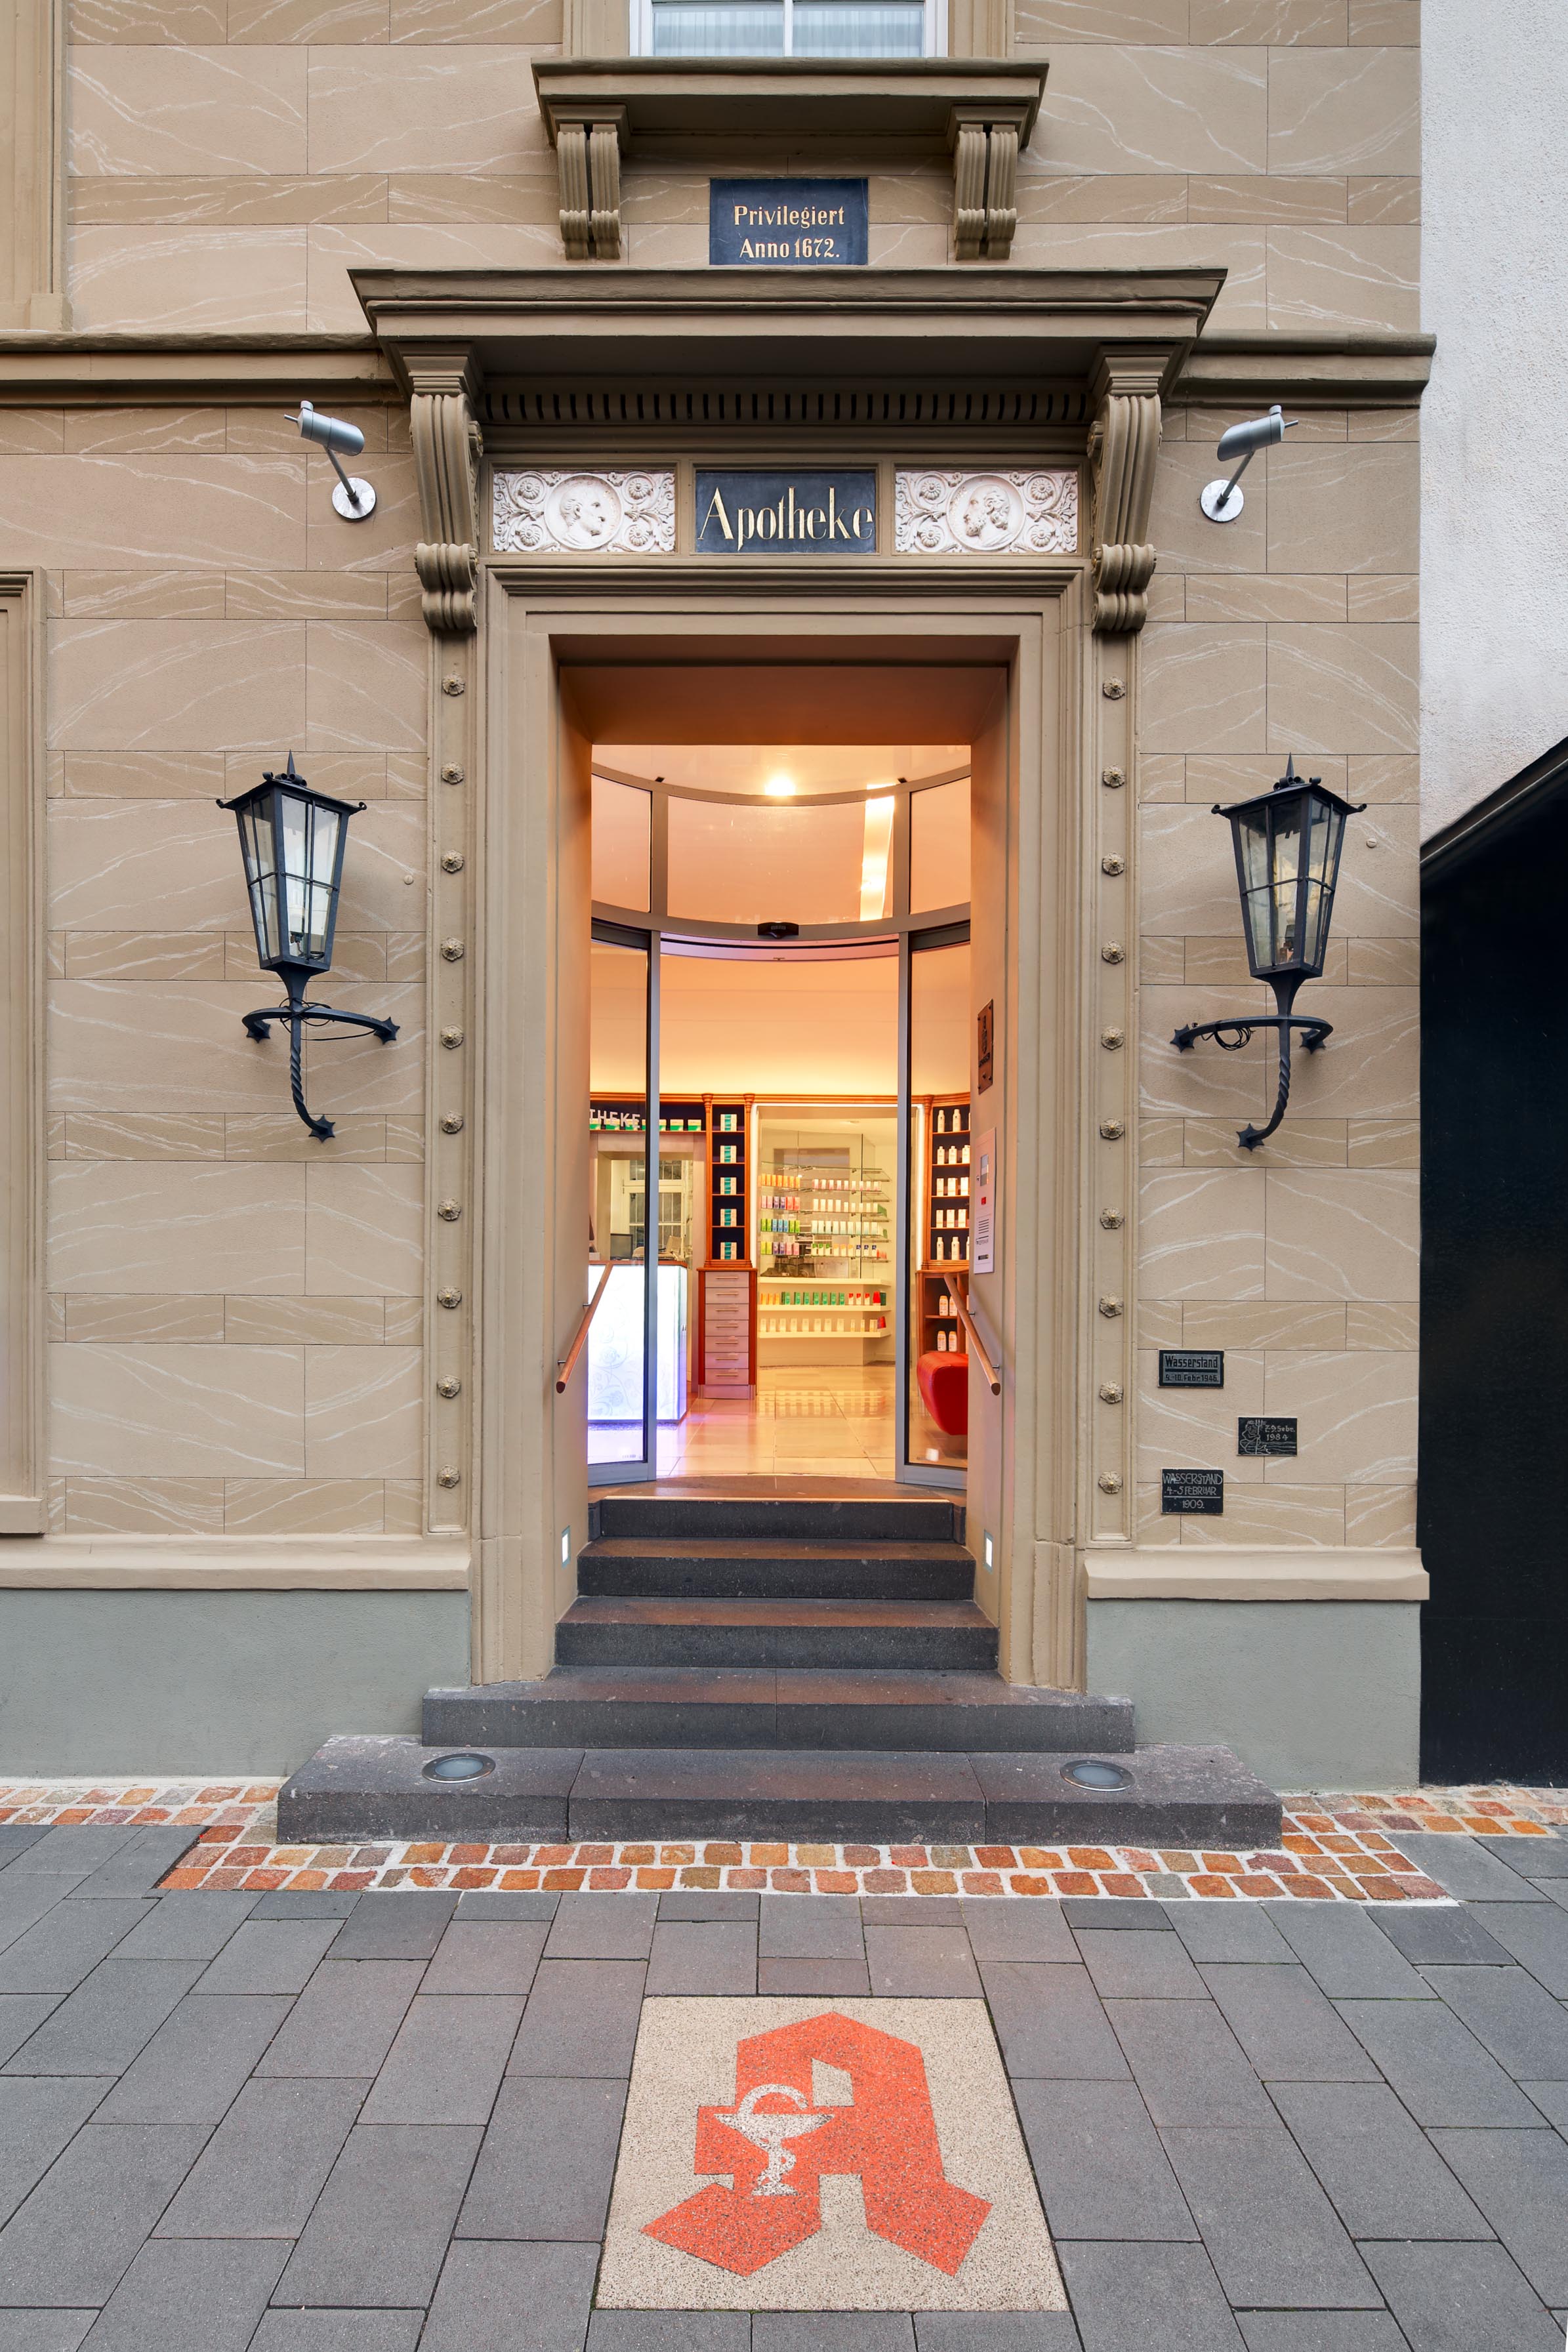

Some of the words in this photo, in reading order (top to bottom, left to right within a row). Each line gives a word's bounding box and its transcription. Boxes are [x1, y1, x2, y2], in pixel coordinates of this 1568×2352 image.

[734, 205, 845, 229] Privilegiert
[739, 238, 789, 258] Anno
[794, 238, 840, 258] 1672.
[697, 485, 873, 552] Apotheke
[1165, 1355, 1218, 1369] Wasserstand
[1163, 1473, 1223, 1485] WASSERSTAND
[1184, 1486, 1217, 1495] FEBRUAR
